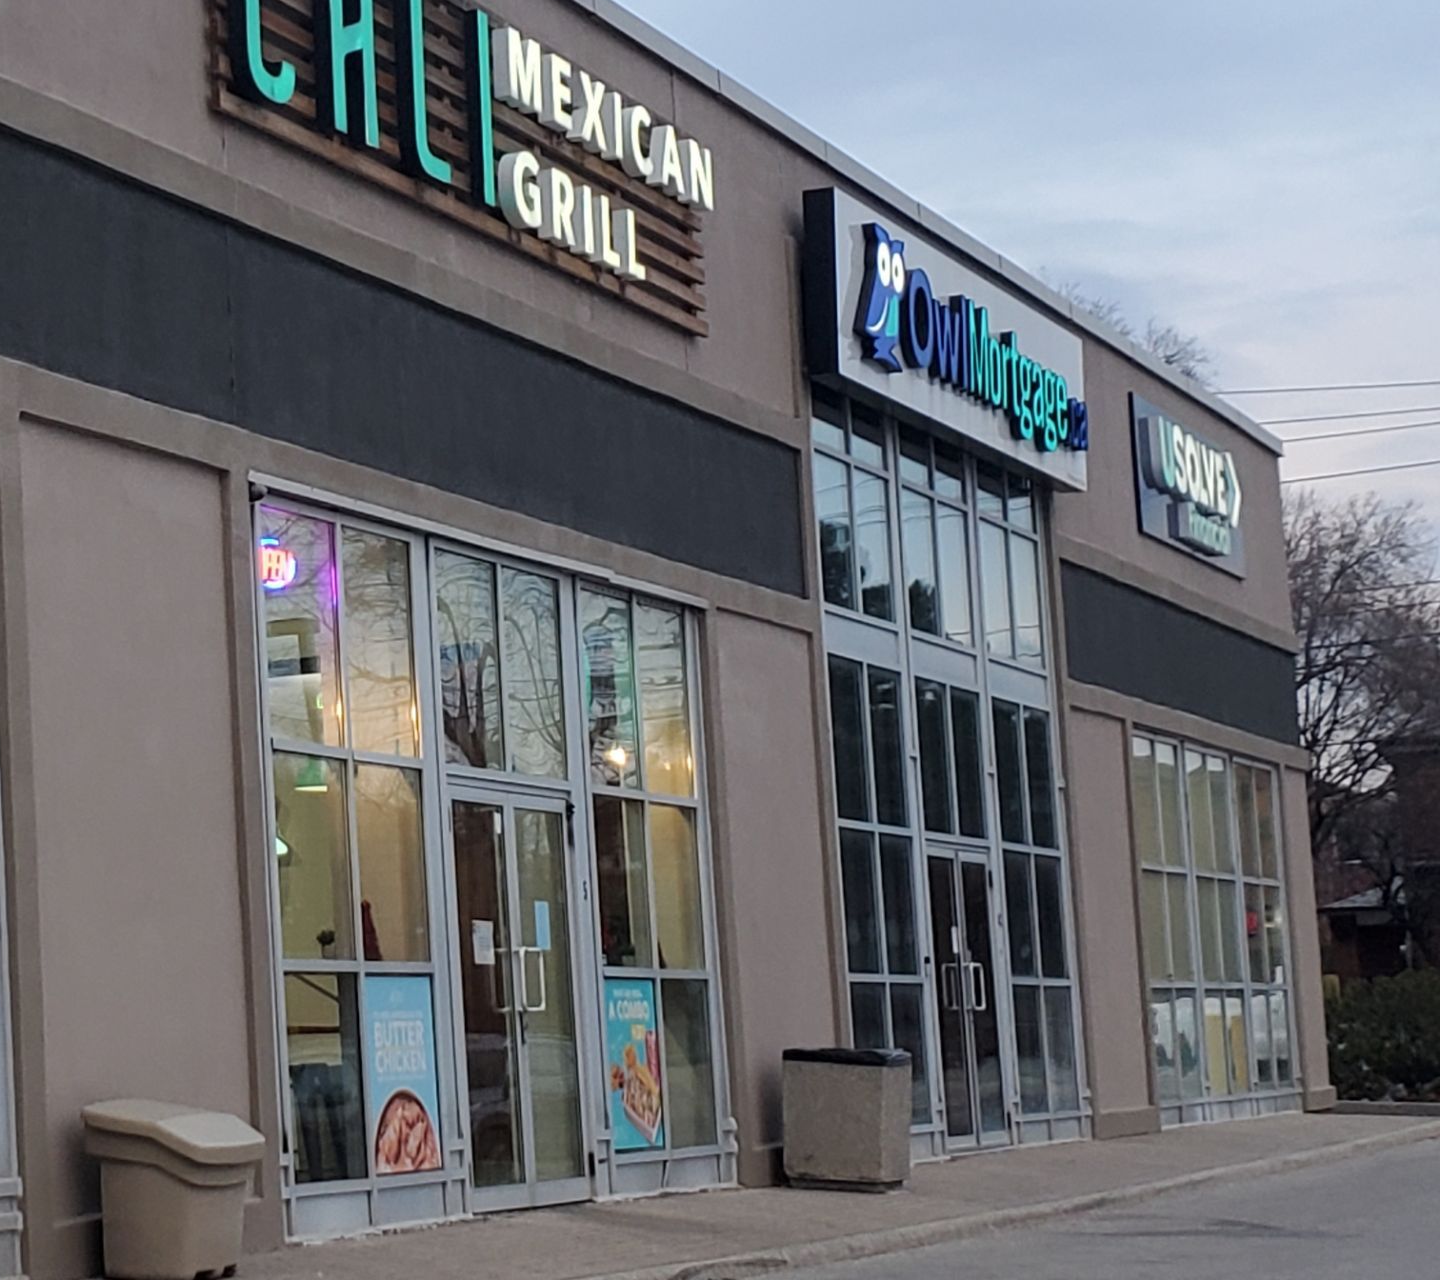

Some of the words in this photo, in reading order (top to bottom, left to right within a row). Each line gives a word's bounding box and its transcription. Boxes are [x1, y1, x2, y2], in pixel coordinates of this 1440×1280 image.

[505, 24, 714, 211] MEXICAN
[512, 150, 647, 282] GRILL
[374, 1020, 425, 1048] BUTTER
